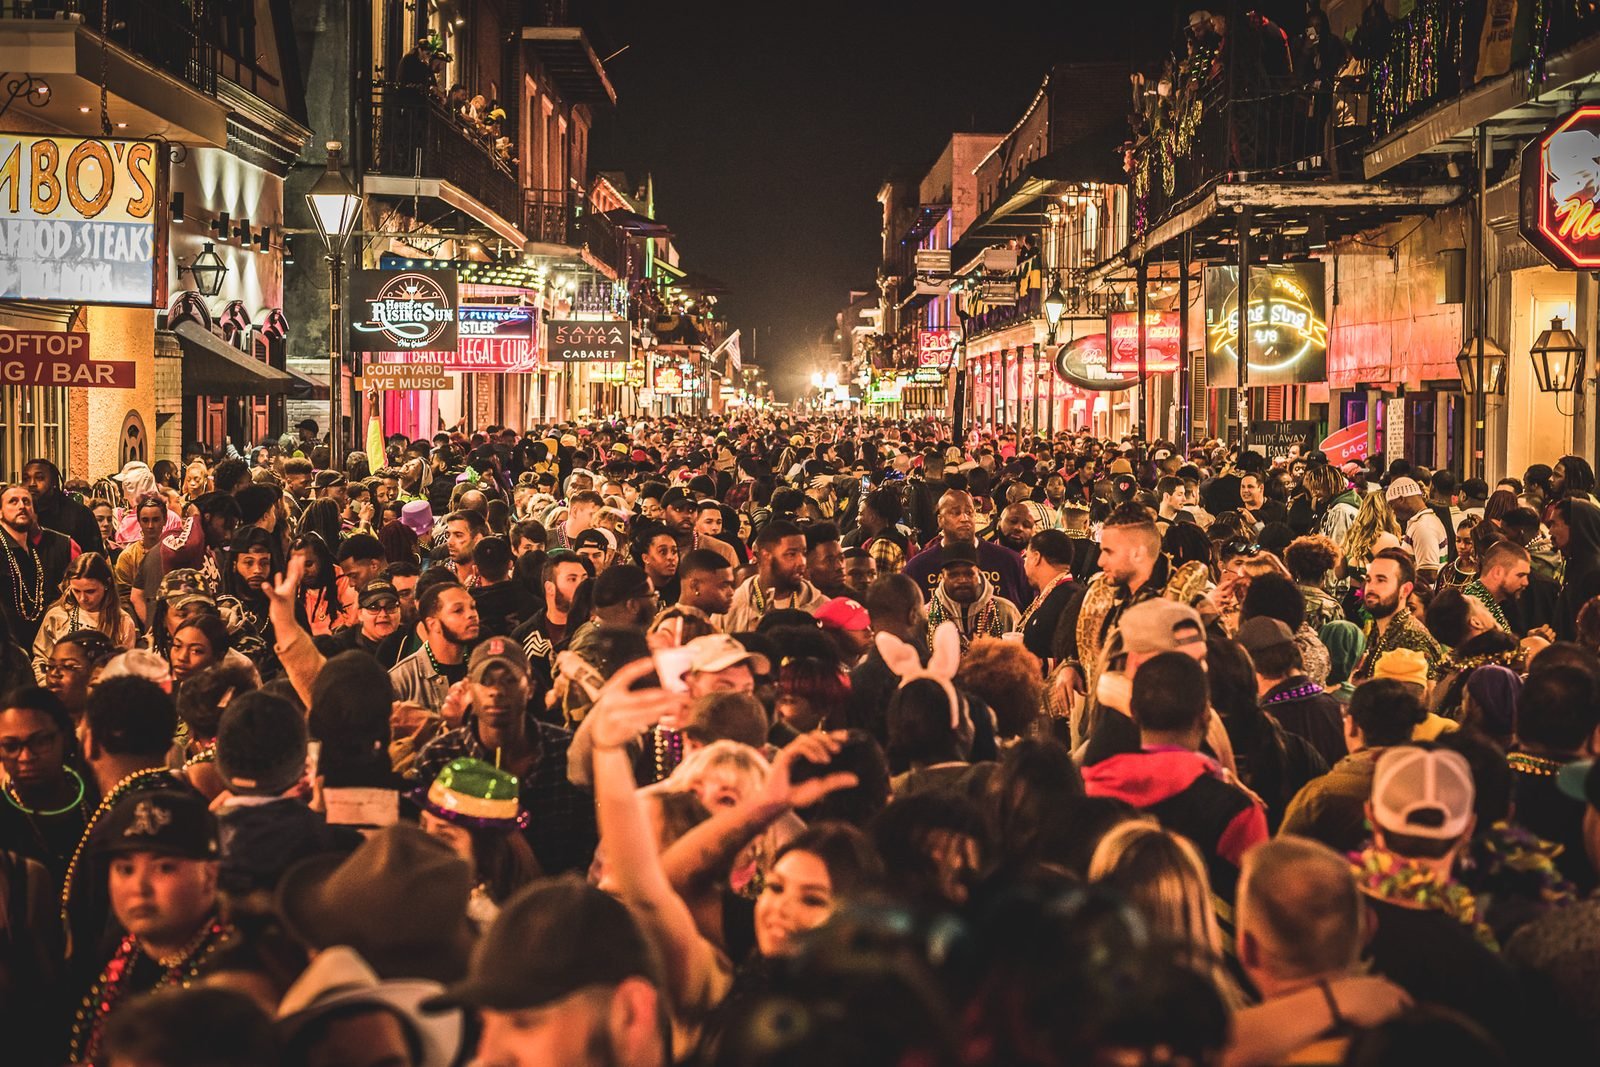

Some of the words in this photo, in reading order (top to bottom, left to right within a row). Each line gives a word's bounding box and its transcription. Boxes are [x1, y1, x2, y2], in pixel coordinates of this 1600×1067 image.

[81, 222, 153, 262] STEAKS
[1228, 305, 1265, 330] Sng
[459, 321, 495, 334] STLER
[557, 326, 622, 335] KAMA
[0, 334, 83, 355] OFTOP
[555, 335, 624, 344] SUTRA
[921, 333, 948, 348] Fat
[461, 338, 497, 364] LEGAL
[500, 339, 529, 364] CLUB
[562, 350, 616, 358] CABARET
[0, 361, 25, 382] G
[53, 363, 115, 384] BAR
[366, 365, 442, 375] COURTYARD
[363, 378, 395, 389] LIVE
[400, 378, 446, 389] MUSIC
[1274, 424, 1291, 433] THE
